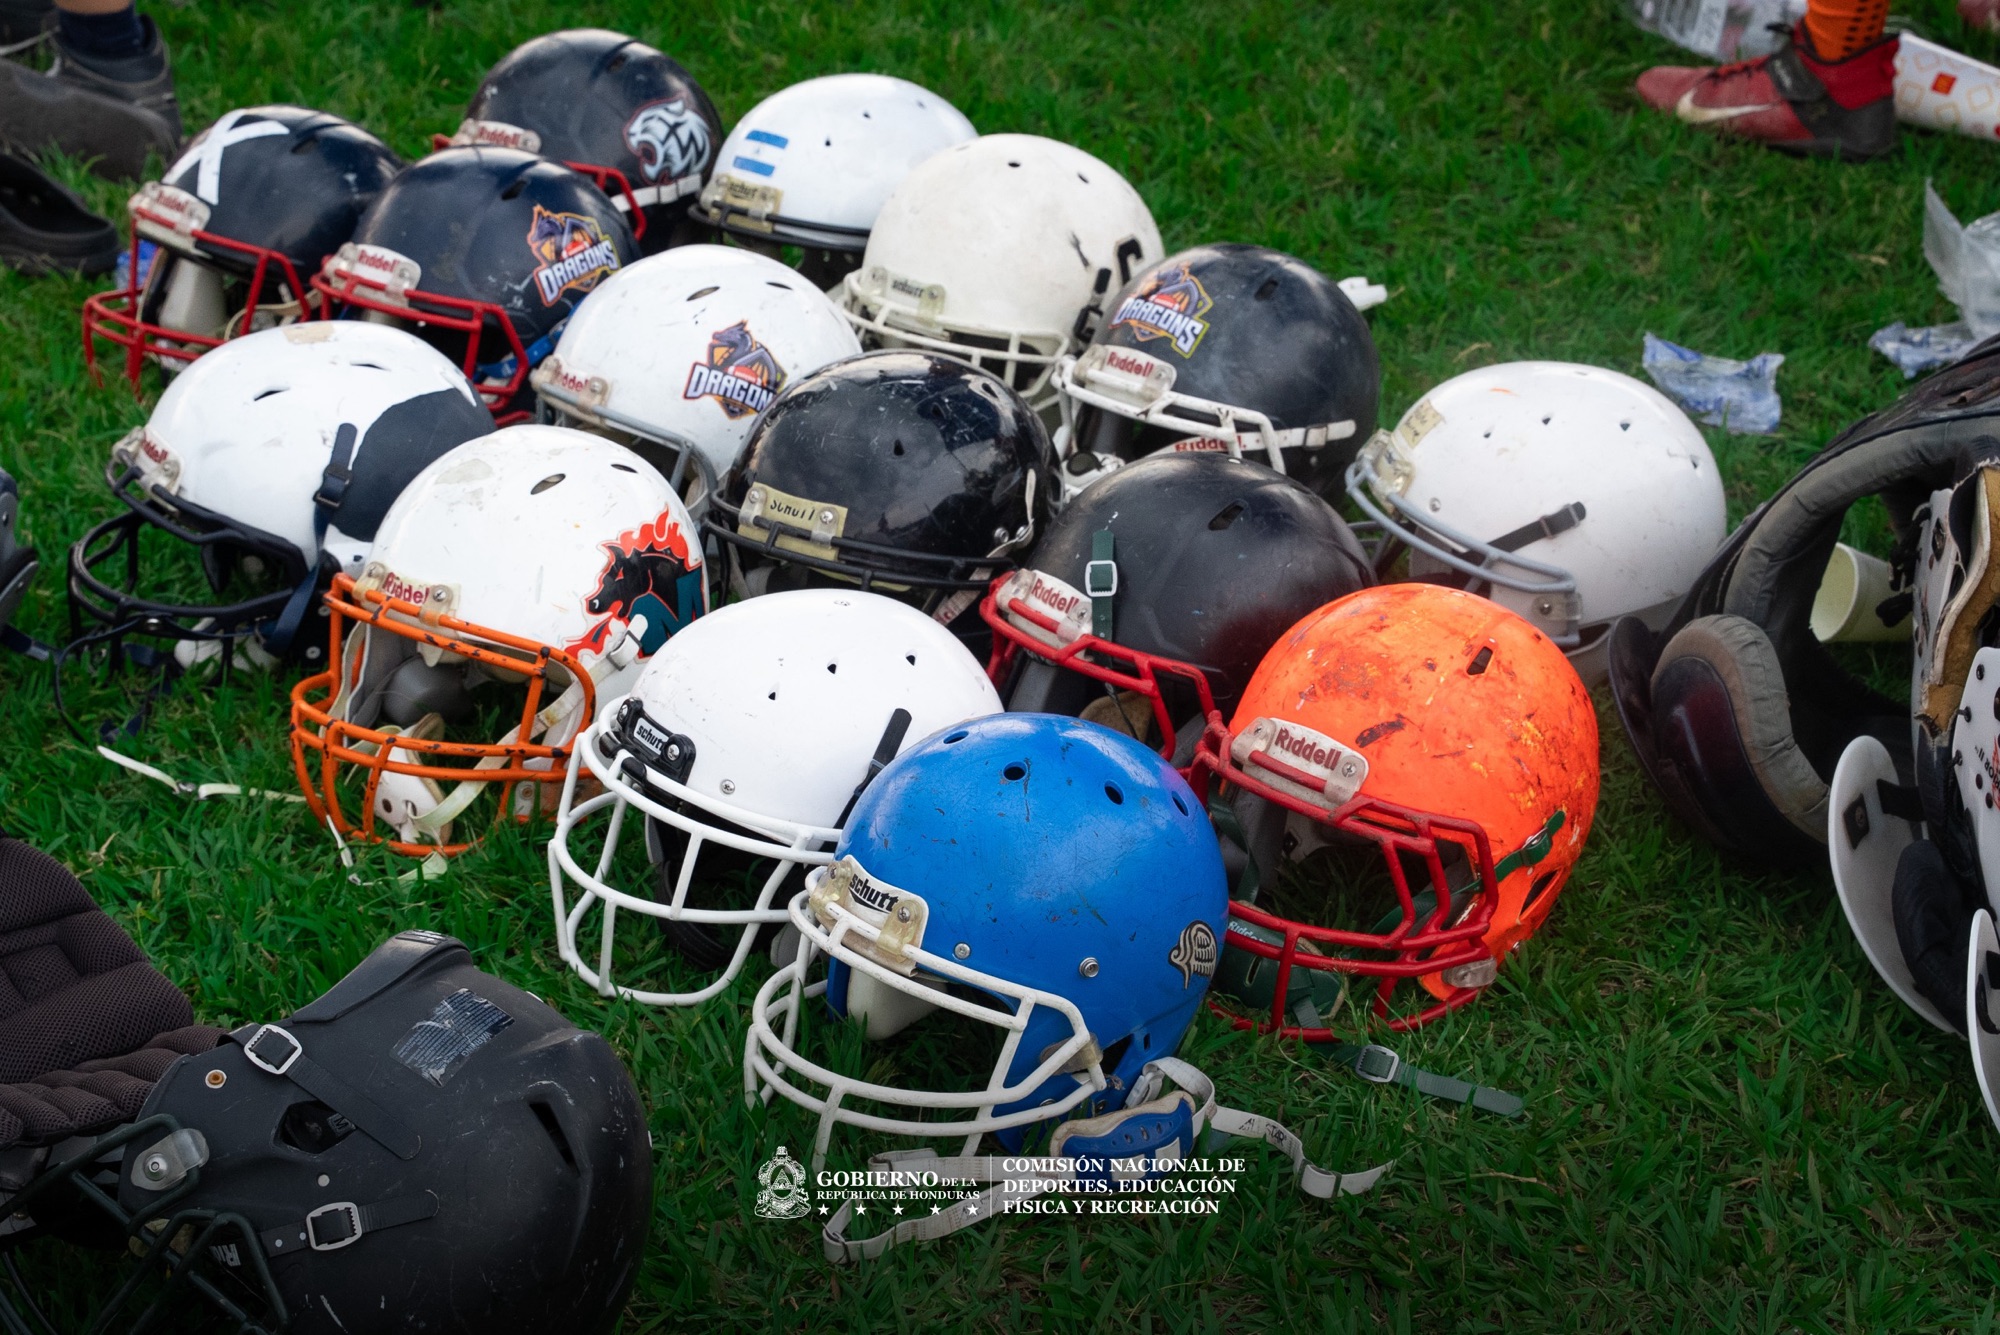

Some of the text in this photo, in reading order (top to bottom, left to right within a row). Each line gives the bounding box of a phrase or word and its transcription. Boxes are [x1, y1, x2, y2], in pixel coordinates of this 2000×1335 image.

[537, 239, 619, 303] DRAGONS
[1111, 297, 1204, 354] DRAGONS
[685, 363, 774, 412] DRAGON
[1106, 351, 1155, 378] Riddell
[1274, 726, 1342, 772] Riddell
[849, 873, 899, 913] schutt
